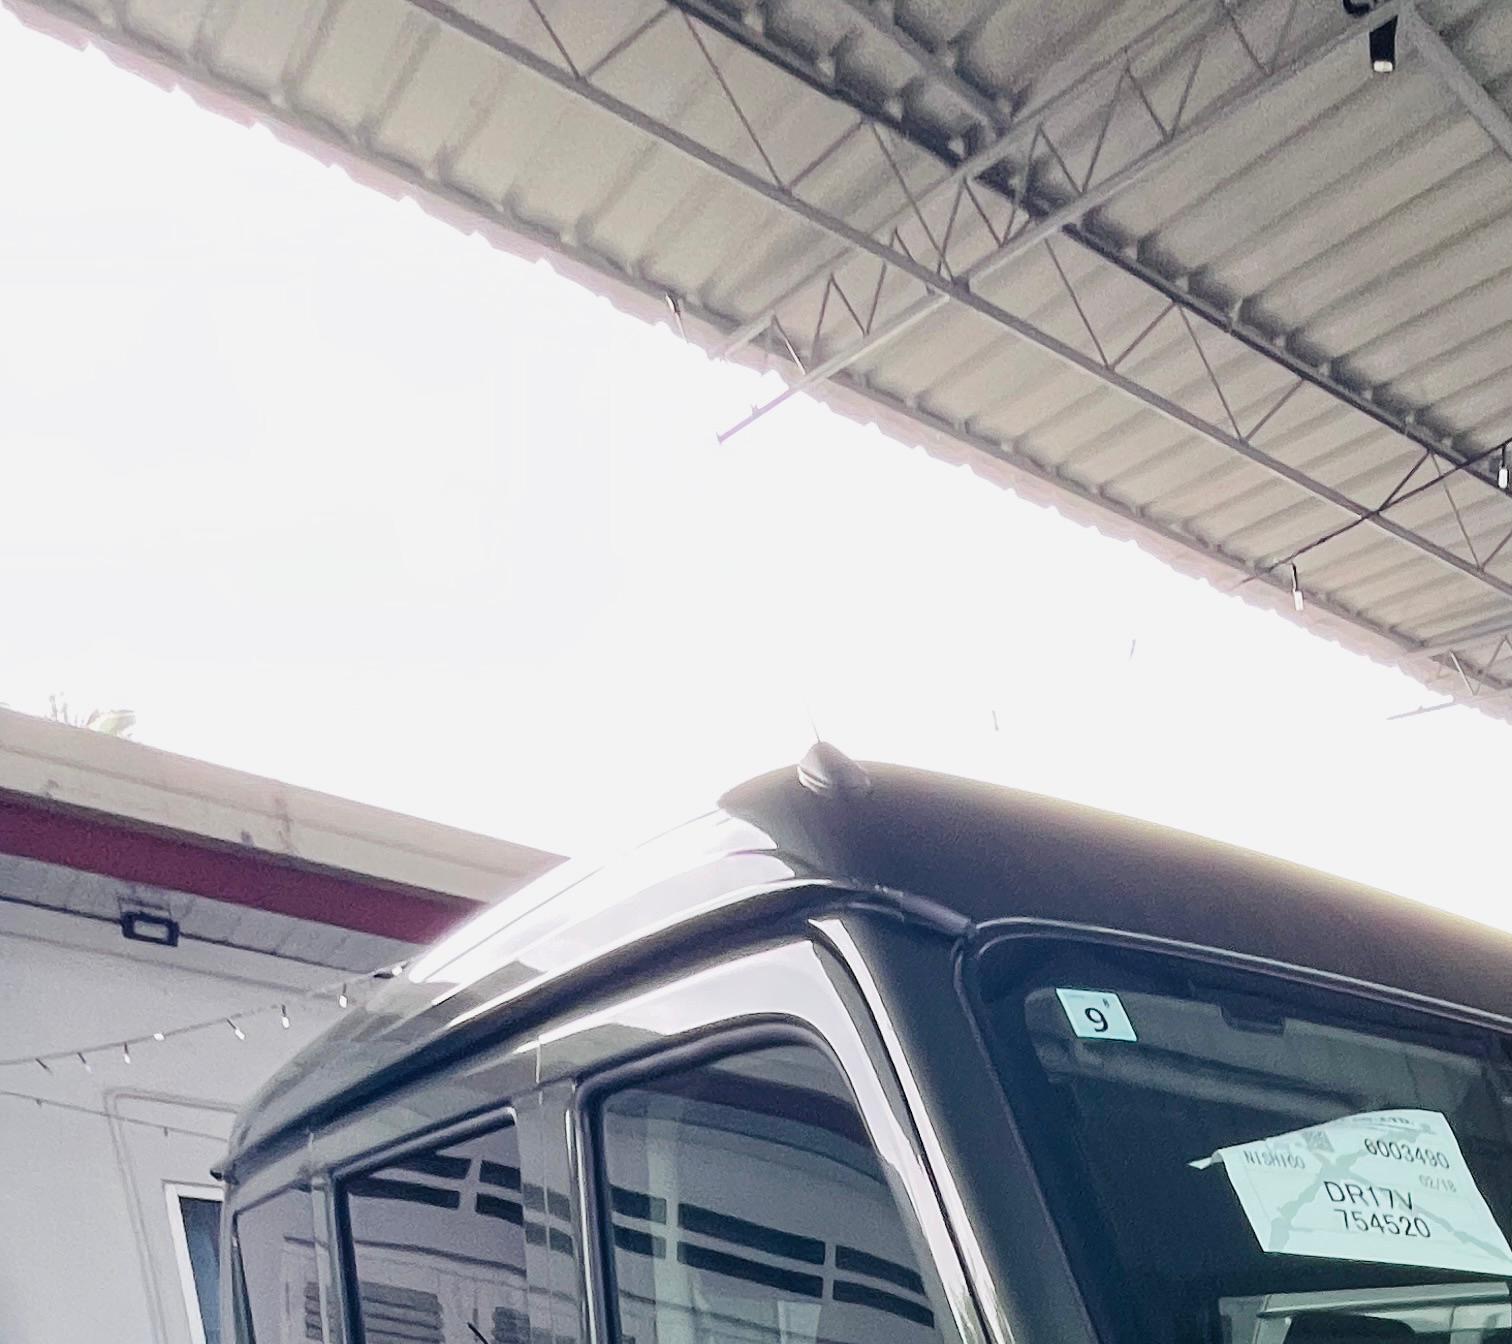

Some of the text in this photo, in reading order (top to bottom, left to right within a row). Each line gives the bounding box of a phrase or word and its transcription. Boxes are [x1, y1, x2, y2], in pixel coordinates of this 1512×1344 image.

[1084, 1007, 1109, 1033] 9
[1323, 1180, 1414, 1211] DR17V
[1333, 1208, 1432, 1238] 754520
